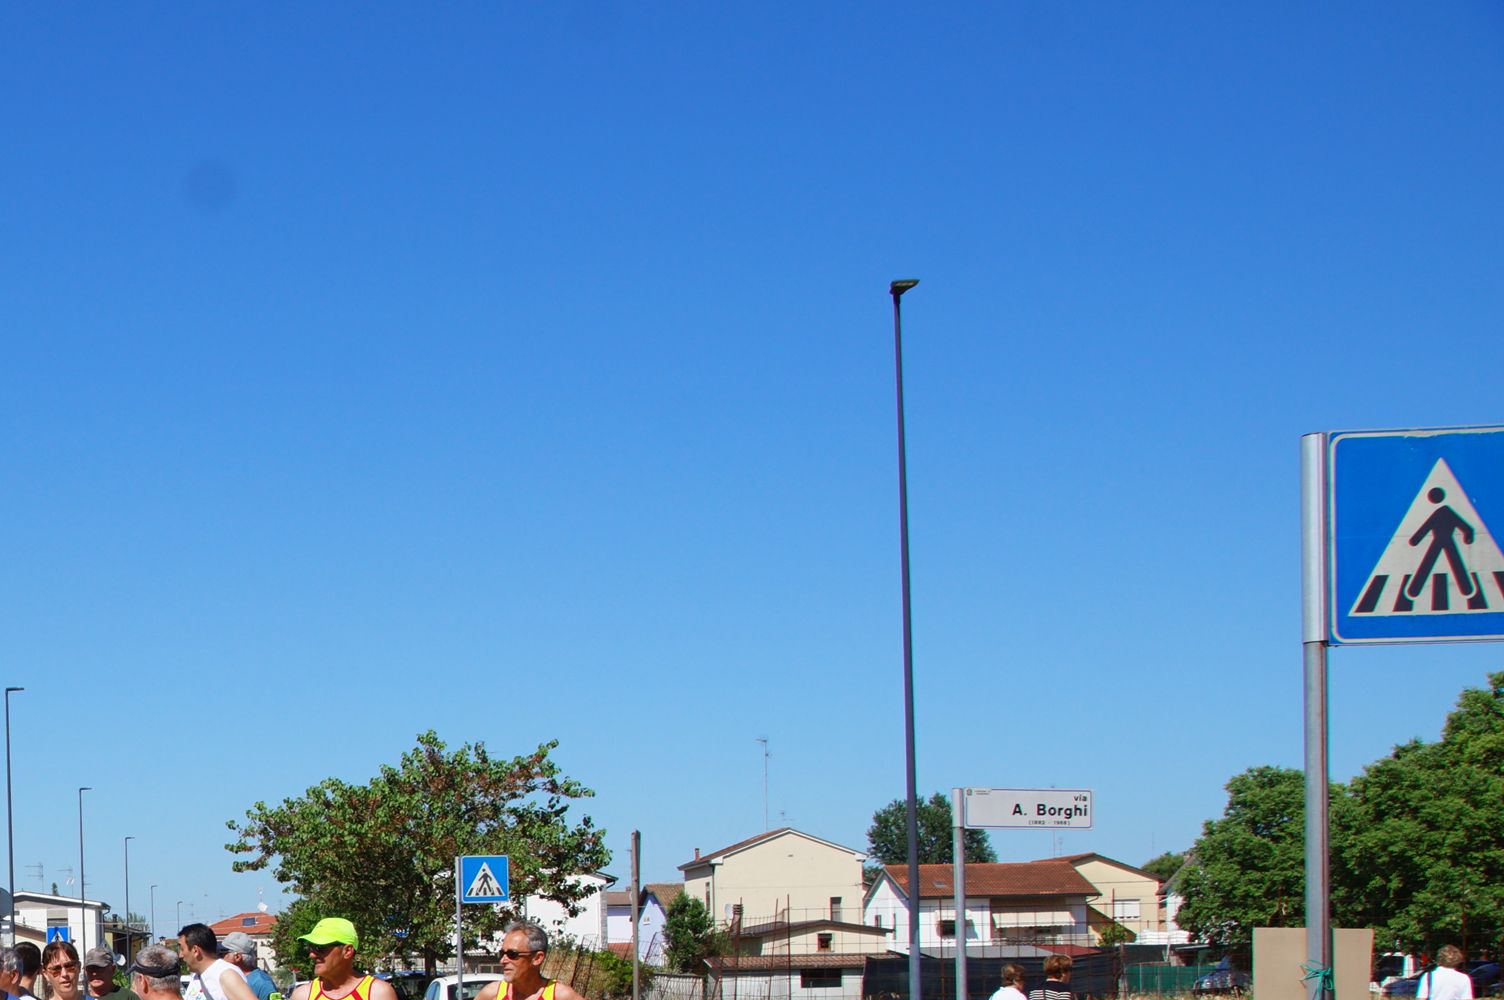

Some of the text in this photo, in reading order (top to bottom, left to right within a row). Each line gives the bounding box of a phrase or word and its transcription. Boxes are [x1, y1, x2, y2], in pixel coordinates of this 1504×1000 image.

[1073, 794, 1088, 802] via
[1012, 803, 1088, 820] A. Borghi
